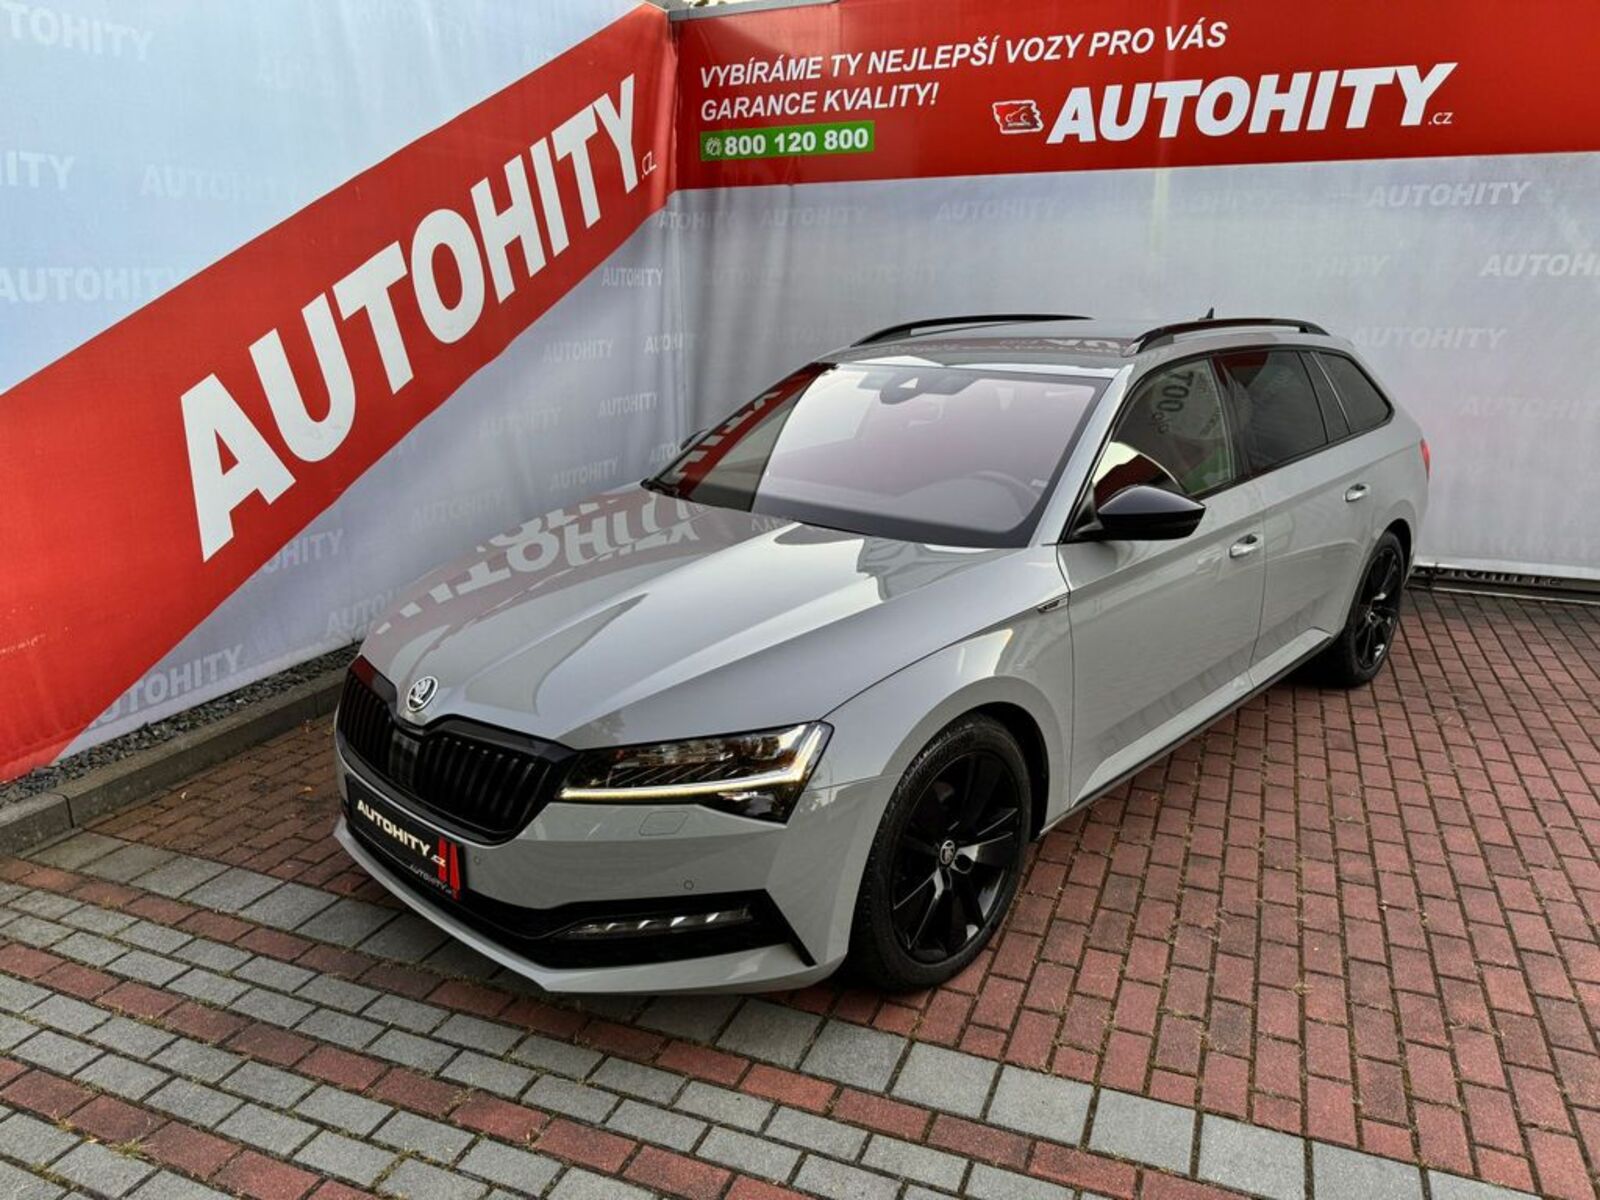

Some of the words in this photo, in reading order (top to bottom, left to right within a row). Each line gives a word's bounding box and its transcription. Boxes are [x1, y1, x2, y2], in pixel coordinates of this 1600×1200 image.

[700, 54, 823, 89] VYBÍRÁME
[831, 53, 863, 78] TY
[867, 34, 1000, 75] NEJLEPŠÍ
[1005, 33, 1084, 64] VOZY
[1088, 27, 1155, 57] PRO
[1165, 17, 1228, 51] VÁS
[701, 91, 817, 121] GARANCE
[823, 82, 940, 112] KVALITY!
[1046, 62, 1458, 145] AUTOHITY
[725, 135, 766, 156] 800
[774, 131, 816, 152] 120
[824, 128, 868, 150] 800
[1364, 181, 1531, 208] AUTOHITY
[600, 266, 664, 289] AUTOHITY
[180, 73, 638, 562] AUTOHITY
[1353, 327, 1507, 351] AUTOHITY
[357, 799, 430, 857] AUTOHITY
